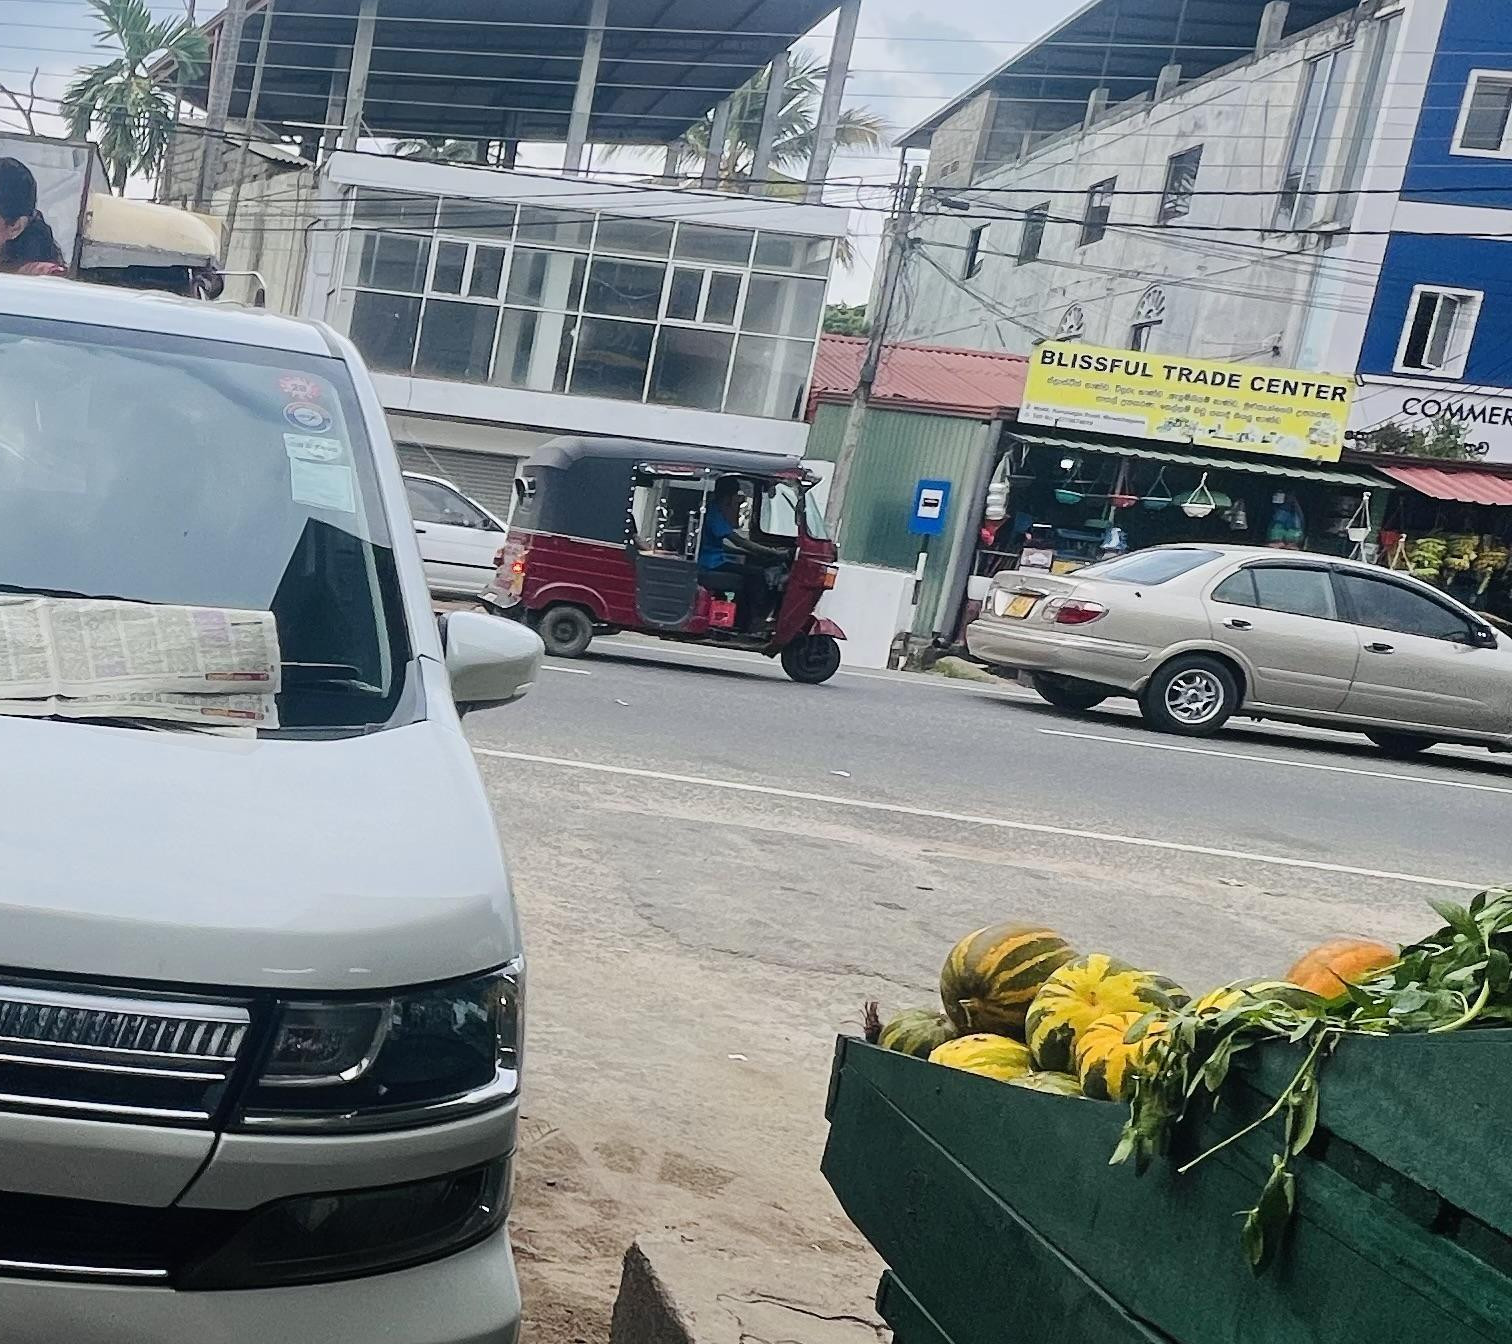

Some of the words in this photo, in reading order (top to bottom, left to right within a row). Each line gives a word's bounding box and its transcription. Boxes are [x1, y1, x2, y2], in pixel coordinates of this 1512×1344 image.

[1041, 350, 1154, 378] BLISSFUL
[1163, 364, 1242, 389] TRADE
[1250, 376, 1347, 402] CENTER
